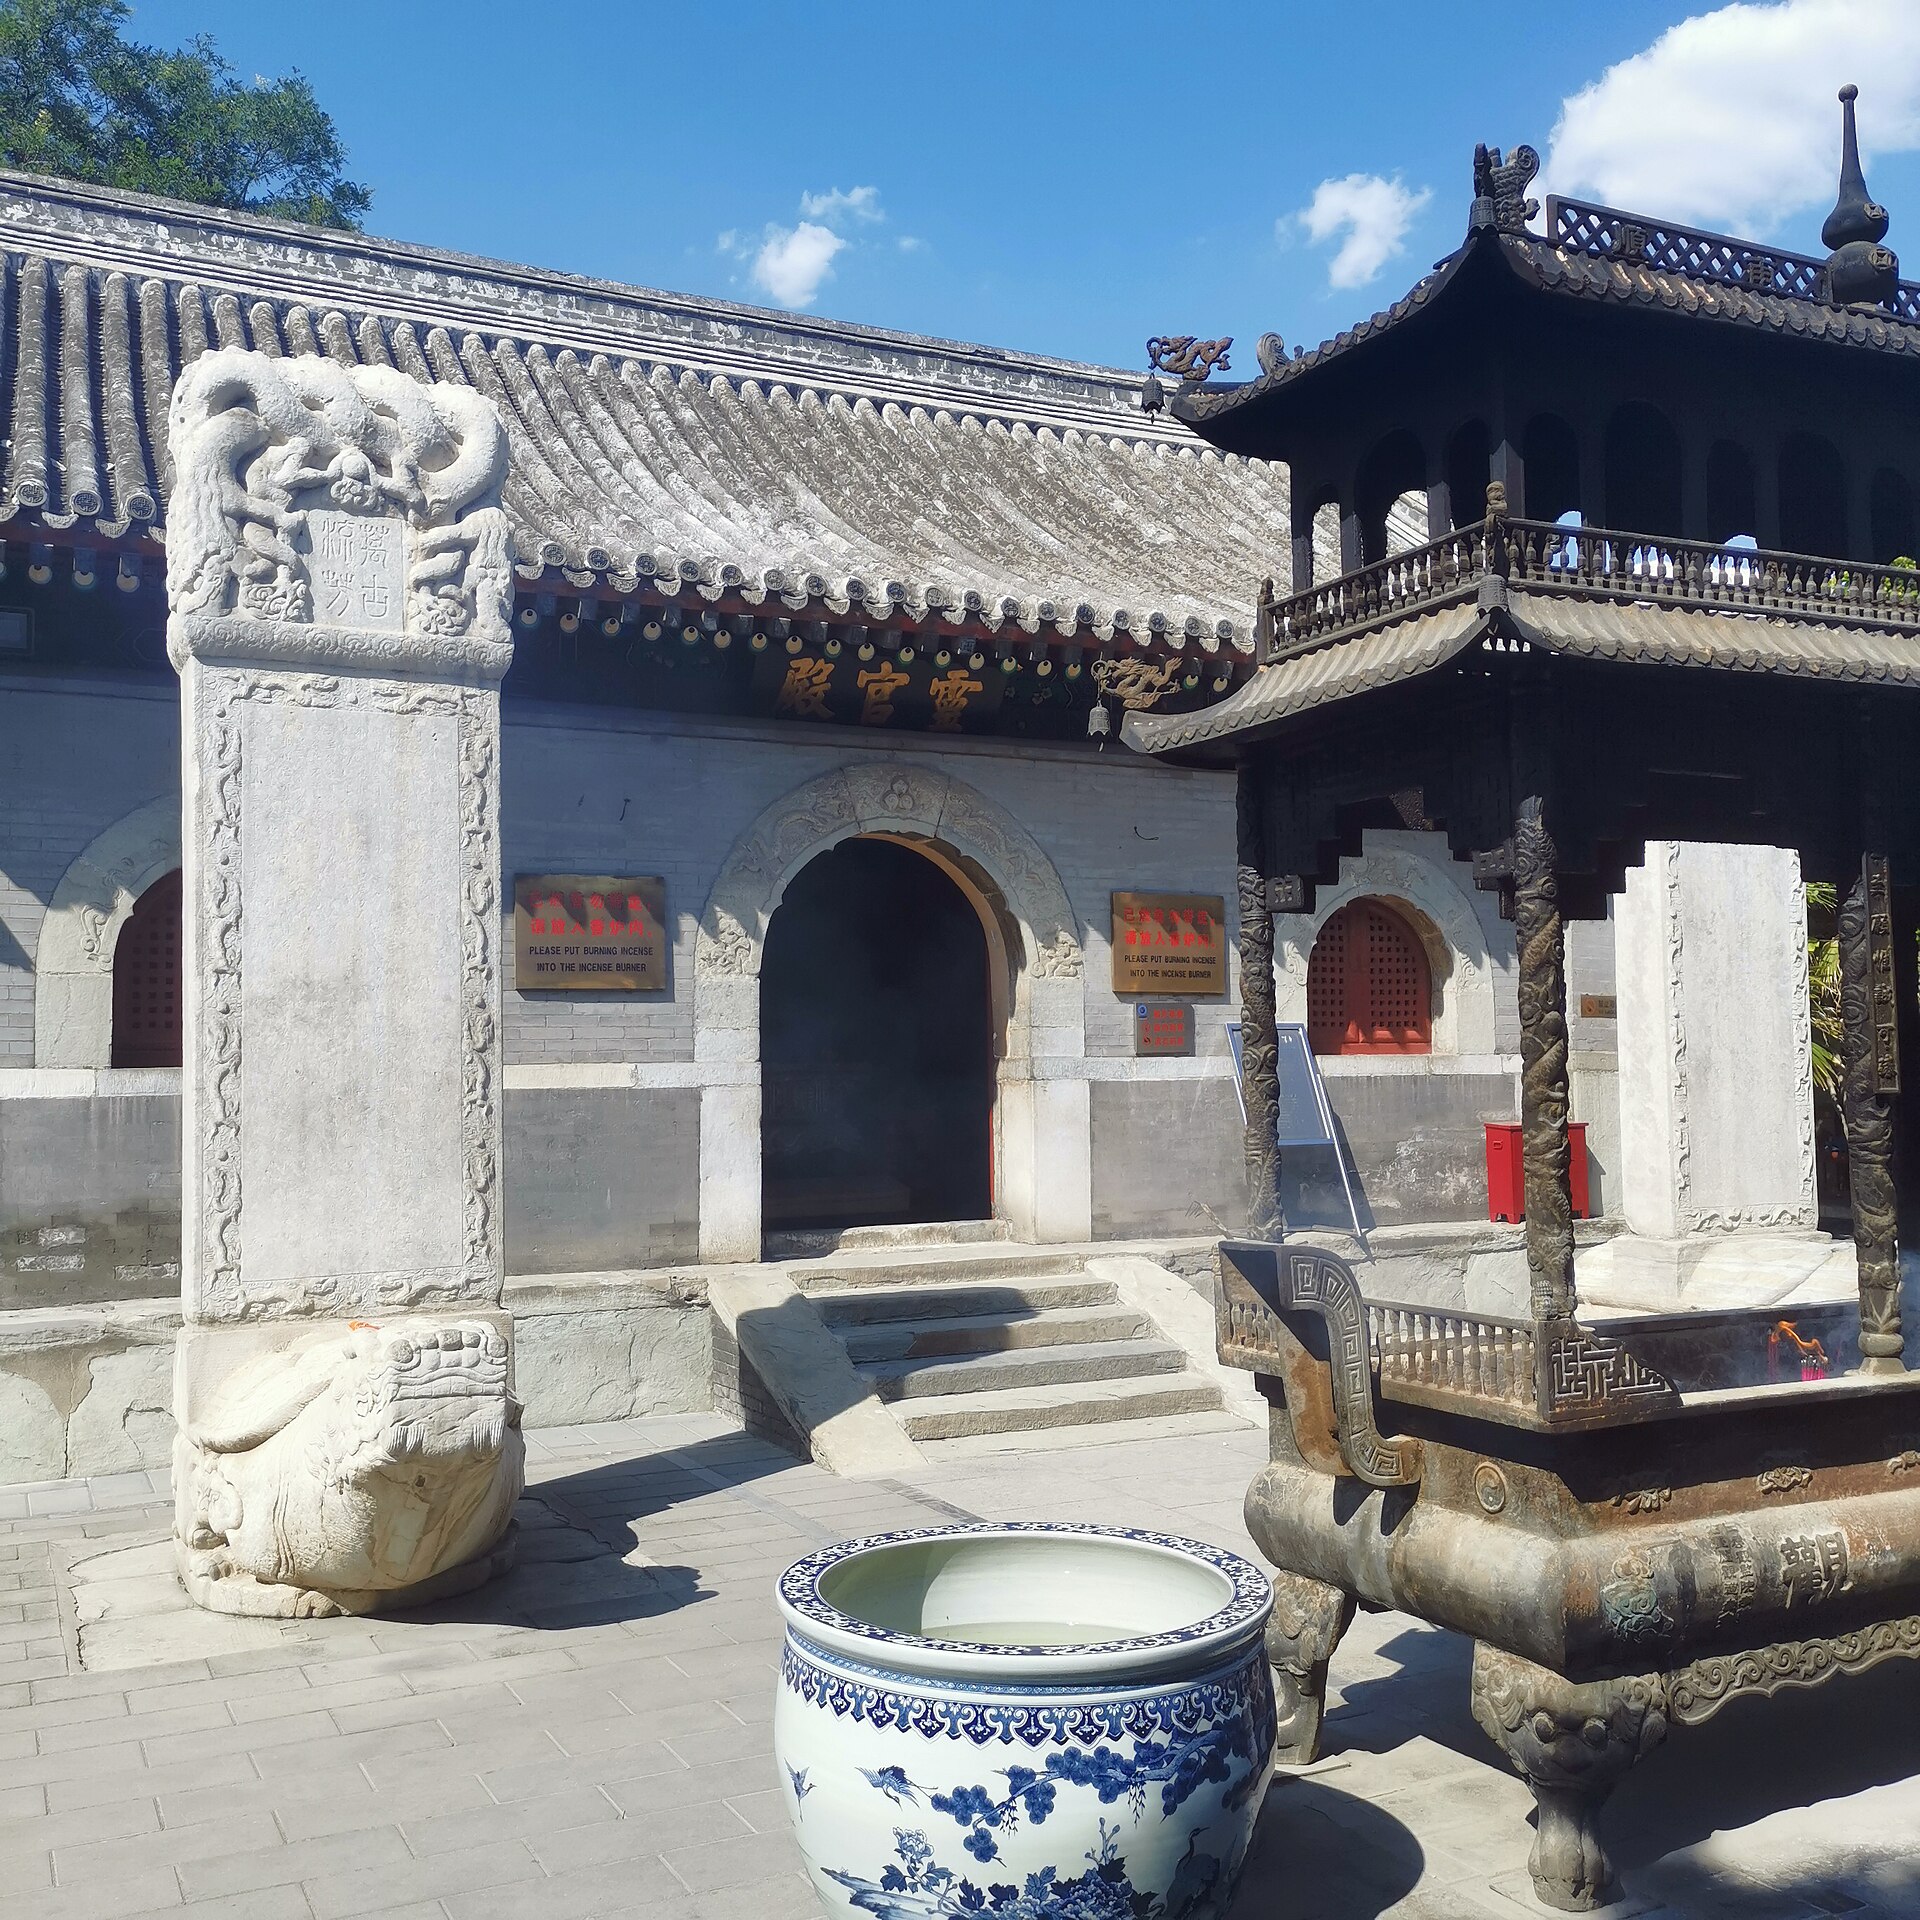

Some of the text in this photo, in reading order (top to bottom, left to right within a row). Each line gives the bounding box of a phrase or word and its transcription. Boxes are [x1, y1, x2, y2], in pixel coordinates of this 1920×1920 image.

[529, 946, 654, 956] PLEASE PUT BURNING INCENSE
[1124, 954, 1217, 965] PLEASE PUT BURNING INCENSE
[536, 962, 647, 972] INTO THE INCENSE BURNER
[1130, 969, 1212, 979] INTO THE INCENSE BURNER
